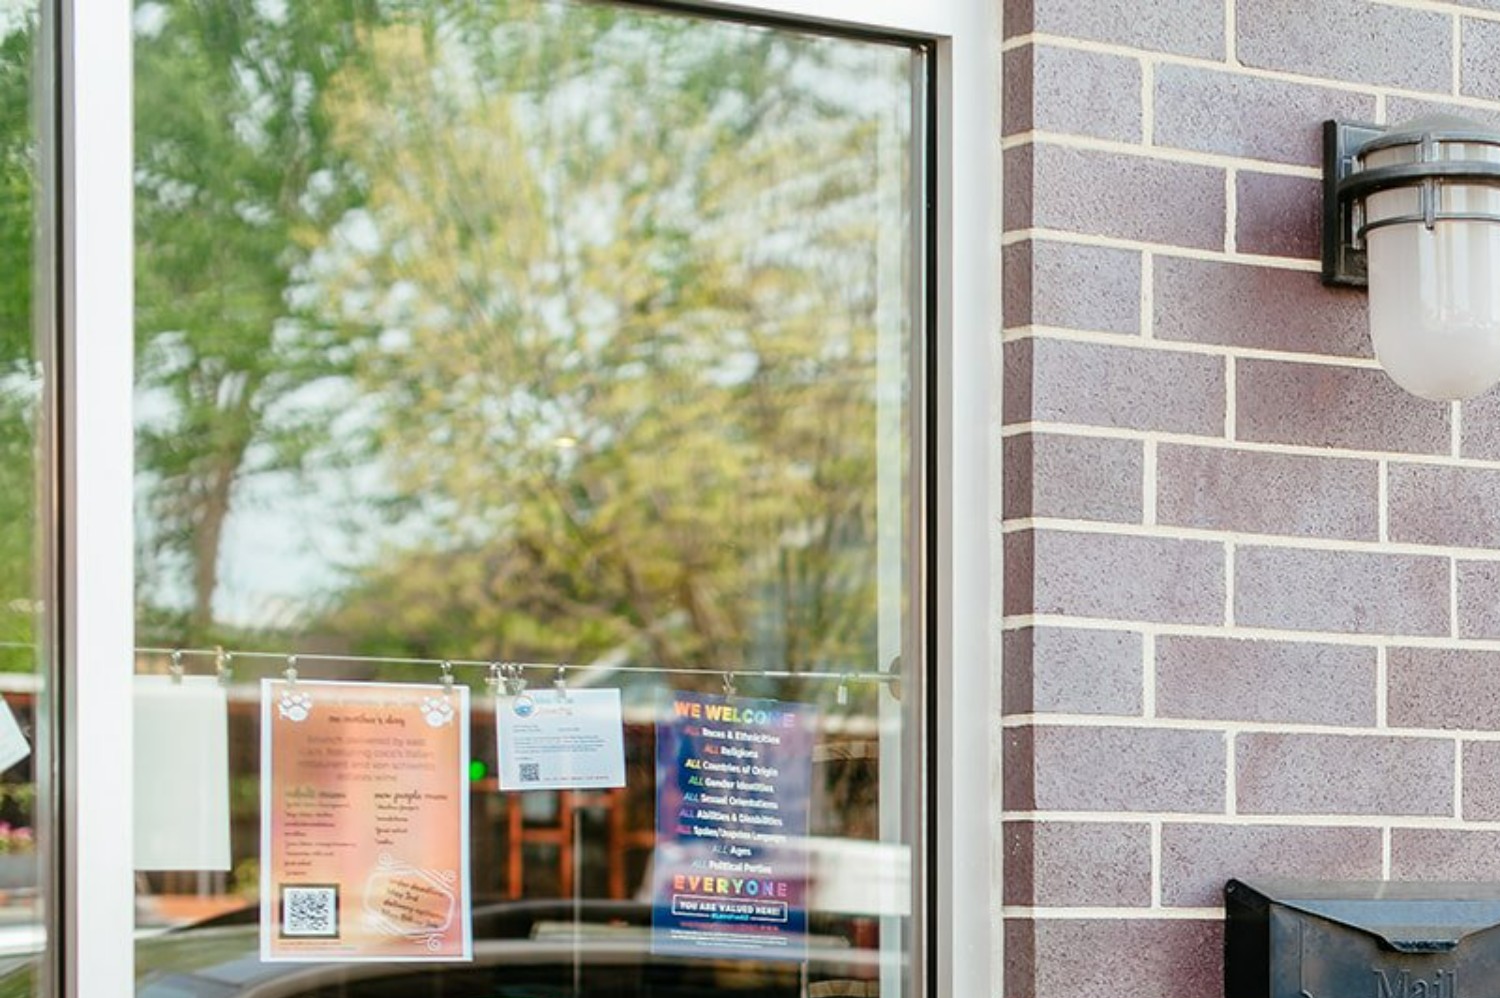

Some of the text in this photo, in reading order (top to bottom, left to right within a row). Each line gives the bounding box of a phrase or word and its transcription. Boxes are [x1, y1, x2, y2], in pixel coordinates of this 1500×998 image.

[674, 702, 796, 728] WE WELCOME
[735, 731, 781, 745] Ethnicities
[721, 746, 758, 759] Religions
[684, 759, 701, 770] ALL
[703, 761, 741, 774] Countries
[752, 766, 779, 779] Origin
[688, 776, 774, 793] ALL Gender Identities
[683, 792, 779, 810] ALL Sexual Orientations
[696, 809, 730, 822] Abilities
[739, 813, 784, 827] Disabilities
[730, 845, 752, 857] Ages
[709, 860, 744, 871] Political
[744, 862, 773, 874] Parties
[674, 874, 787, 897] EVERYONE
[680, 901, 698, 911] YOU
[700, 902, 716, 912] ARE
[717, 903, 754, 914] VALUED
